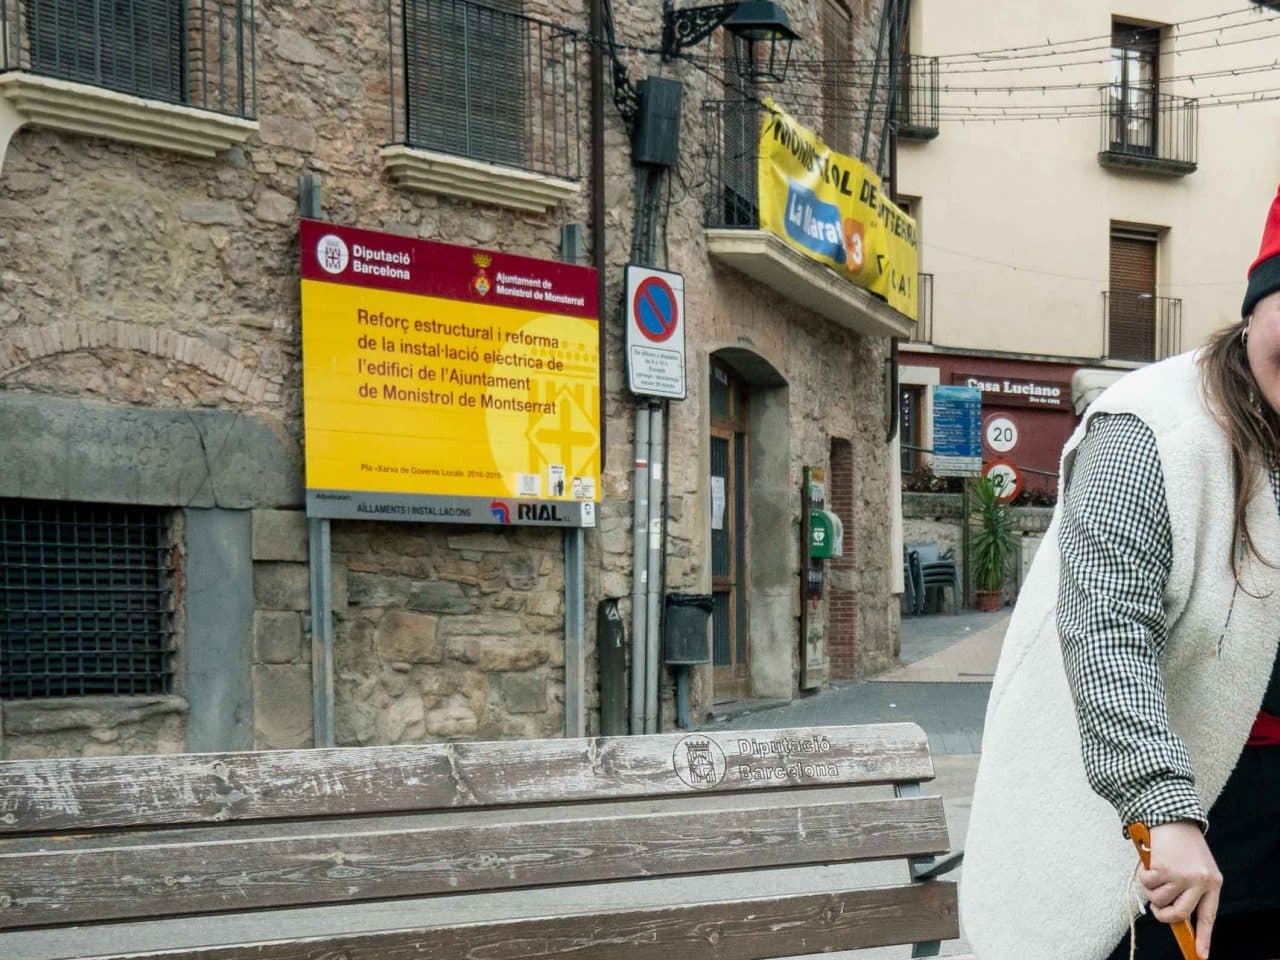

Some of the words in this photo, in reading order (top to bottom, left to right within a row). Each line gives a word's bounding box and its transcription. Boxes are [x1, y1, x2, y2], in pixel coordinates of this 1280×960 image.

[860, 178, 878, 209] DE
[789, 193, 802, 227] La
[353, 244, 411, 265] Diputació
[852, 232, 863, 265] 3
[353, 260, 411, 280] Barcelona
[496, 272, 541, 289] Ajuntament
[542, 279, 553, 289] de
[496, 285, 533, 298] Monistrol
[534, 289, 544, 300] de
[358, 309, 409, 334] Reforç
[414, 319, 493, 341] estructural
[505, 331, 559, 349] reforma
[358, 334, 377, 350] de
[382, 337, 395, 352] la
[400, 339, 479, 362] instal·lació
[547, 357, 564, 371] de
[358, 358, 413, 378] l'edifici
[418, 365, 437, 380] de
[441, 367, 531, 391] l'Ajuntament
[967, 378, 1000, 393] Casa
[1003, 381, 1061, 397] Luciano
[358, 383, 378, 398] de
[383, 385, 454, 405] Monistrol
[458, 392, 476, 407] de
[480, 394, 557, 414] Montserrat
[993, 427, 1013, 442] 20
[518, 503, 563, 522] RIAL
[737, 735, 832, 757] Diputació
[739, 762, 839, 781] Barcelona
